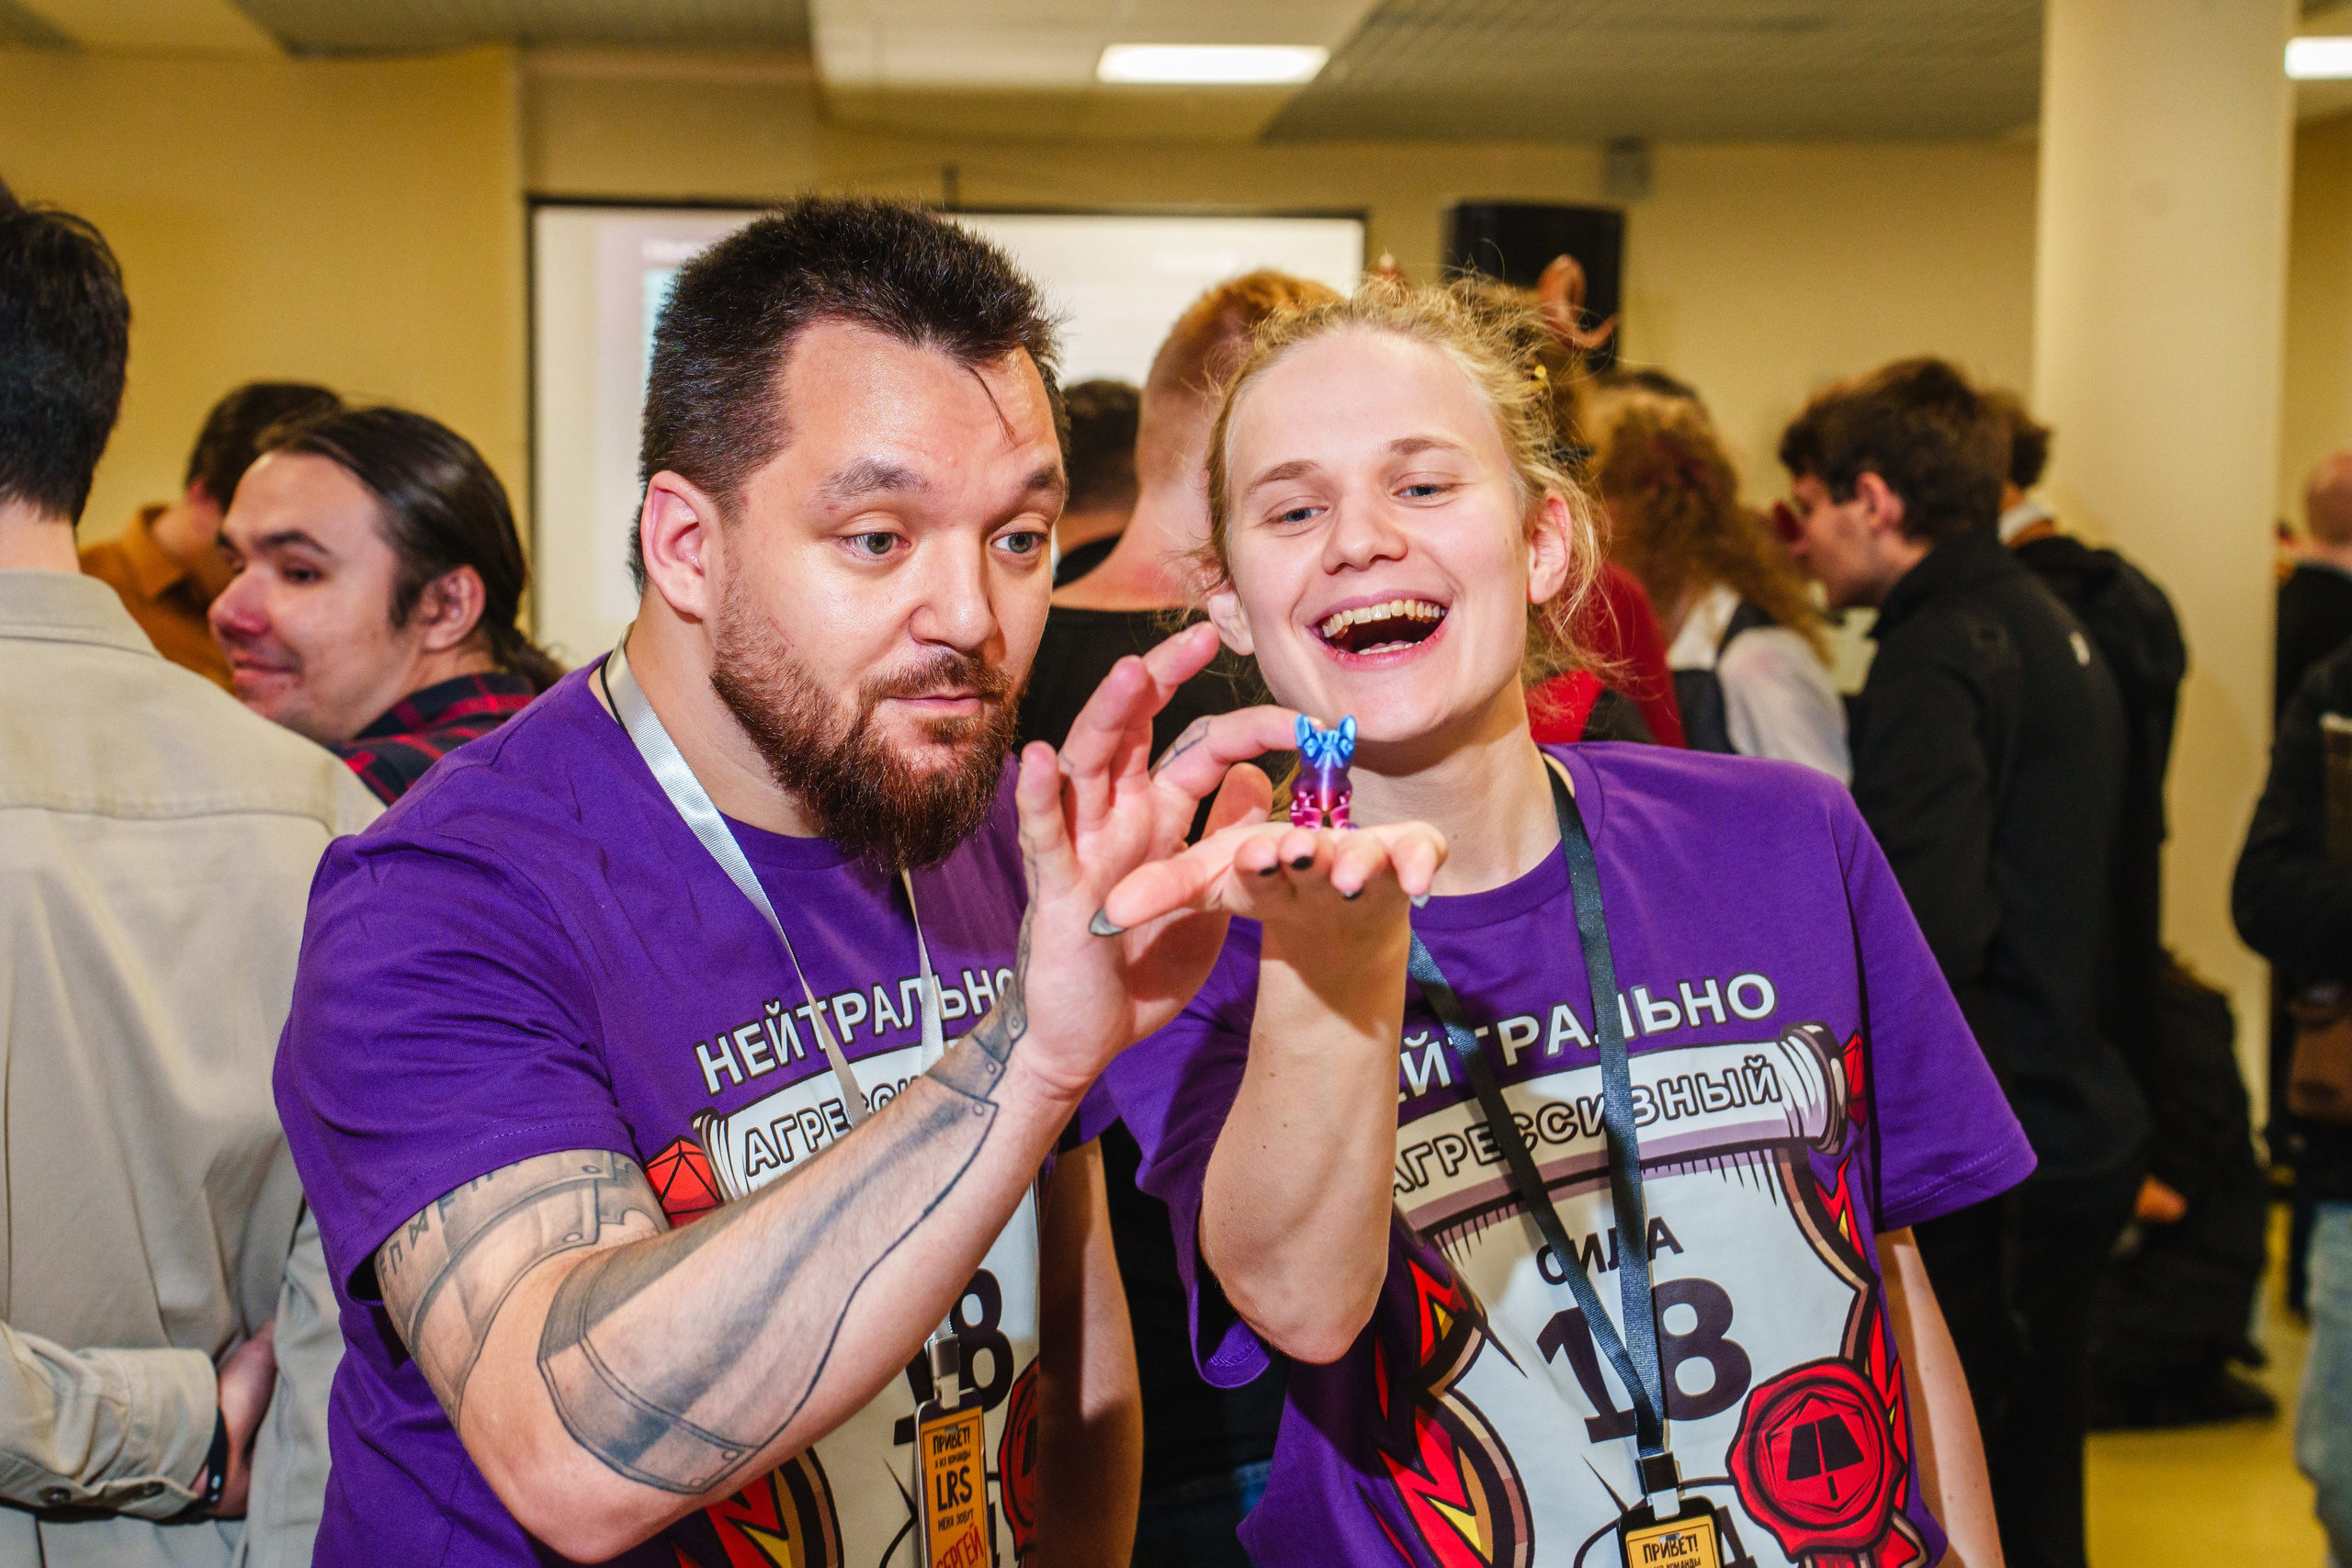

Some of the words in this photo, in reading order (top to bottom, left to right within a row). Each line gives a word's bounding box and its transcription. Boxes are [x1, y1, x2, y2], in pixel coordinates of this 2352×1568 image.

[694, 967, 1014, 1096] НЕЙТРАЛЬНО
[1398, 971, 1777, 1103] ЙРАЬНО
[1535, 1277, 1753, 1444] 18
[933, 1425, 970, 1456] ПРИВЕТ!
[935, 1465, 973, 1512] LRS
[937, 1516, 955, 1532] МЕНЯ
[956, 1507, 974, 1525] ЗОВУТ
[1642, 1533, 1699, 1563] ПРИВЕТ!
